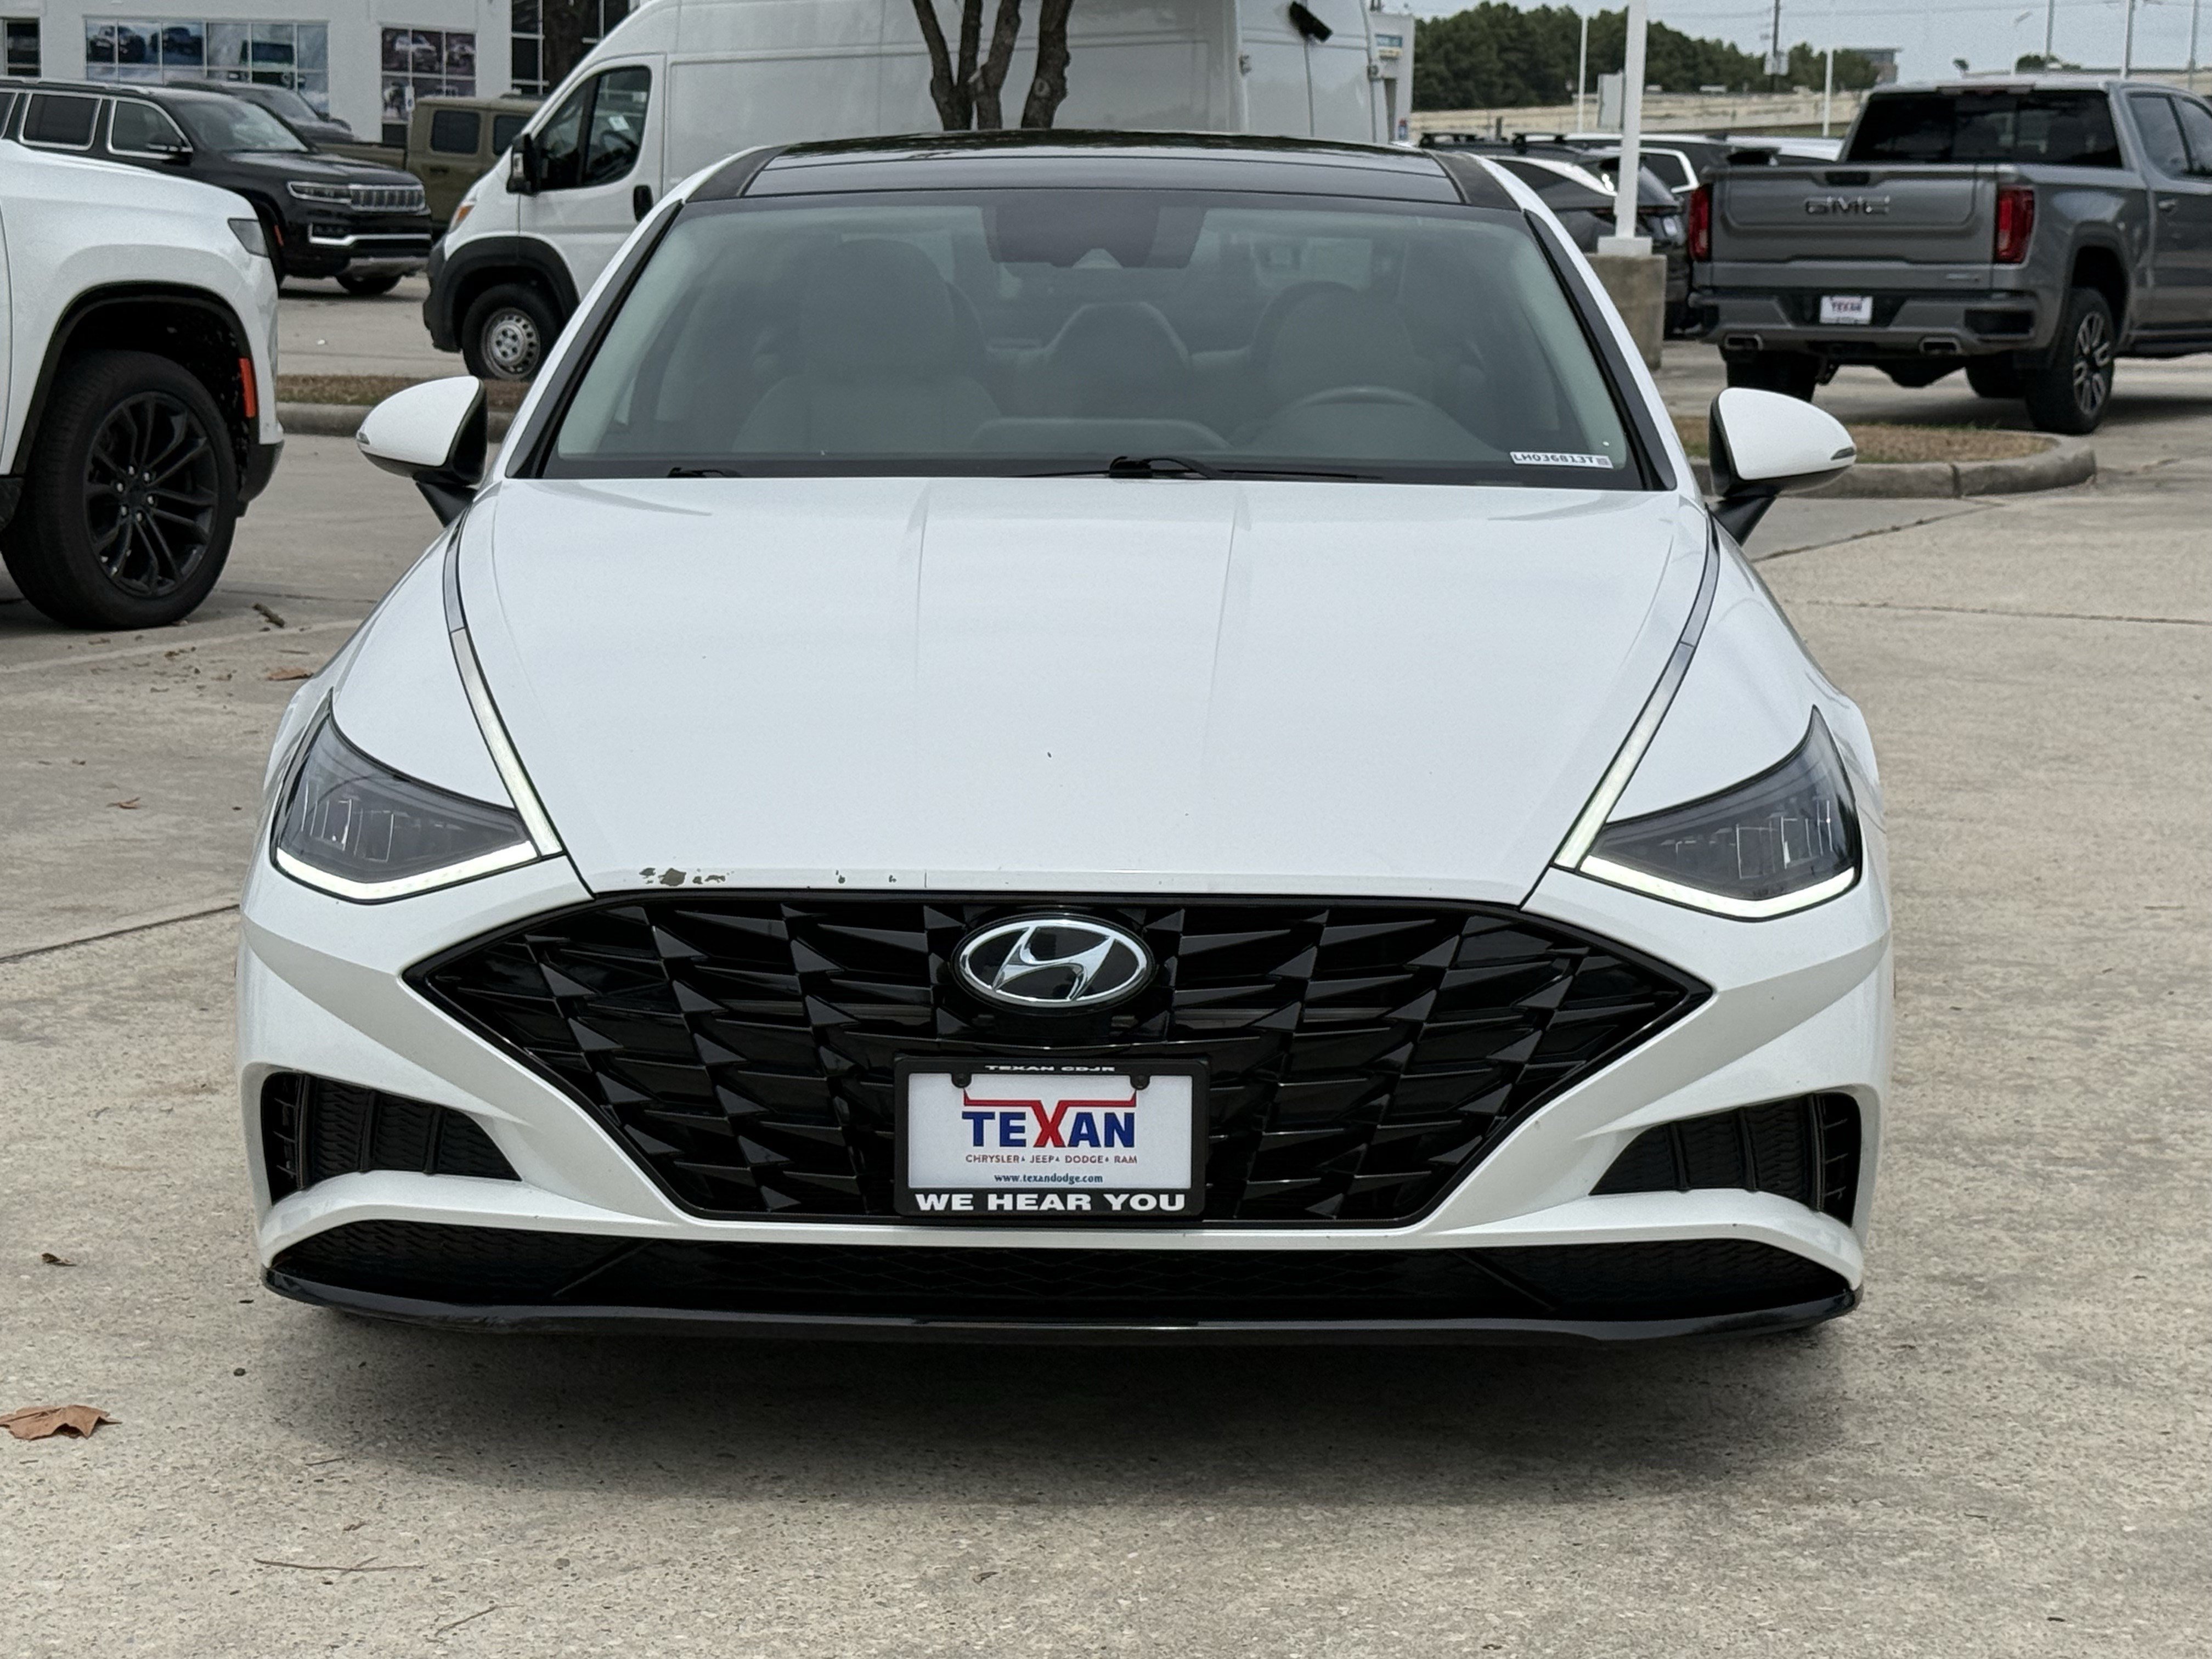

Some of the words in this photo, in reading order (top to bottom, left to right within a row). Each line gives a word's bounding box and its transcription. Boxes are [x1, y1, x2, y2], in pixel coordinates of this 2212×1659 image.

[1804, 195, 1891, 215] GMC
[962, 1100, 1135, 1148] TEXAN
[966, 1154, 1020, 1163] CHRYSLER
[1030, 1155, 1054, 1163] JEEP
[1065, 1155, 1104, 1164] DODGE
[1114, 1155, 1137, 1164] RAM
[994, 1173, 1103, 1184] www.texandodge.com
[915, 1193, 974, 1211] WE
[988, 1194, 1092, 1211] HEAR
[1103, 1194, 1185, 1212] YOU
